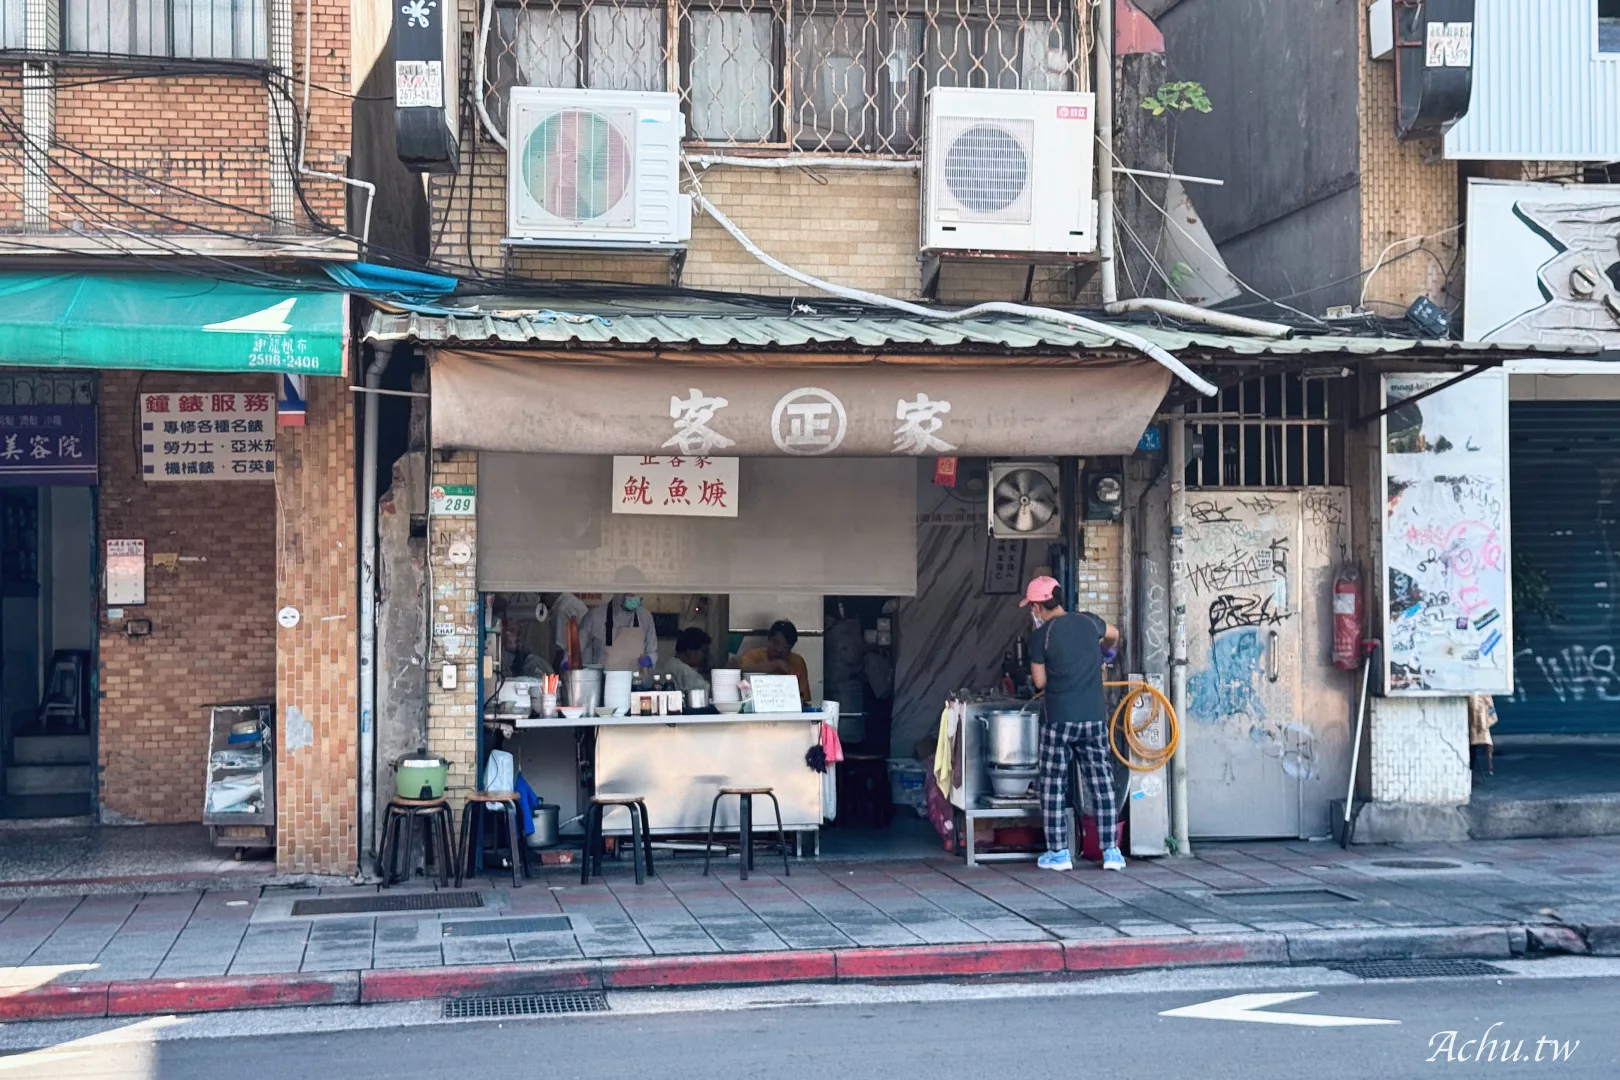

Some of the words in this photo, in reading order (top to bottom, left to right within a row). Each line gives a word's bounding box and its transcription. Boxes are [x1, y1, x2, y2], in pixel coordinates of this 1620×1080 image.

[248, 353, 320, 369] 2596-2406
[145, 394, 269, 413] 鐘錶服務
[163, 419, 264, 434] 專修各種名錶
[0, 433, 83, 461] 美容院
[445, 498, 471, 511] 289
